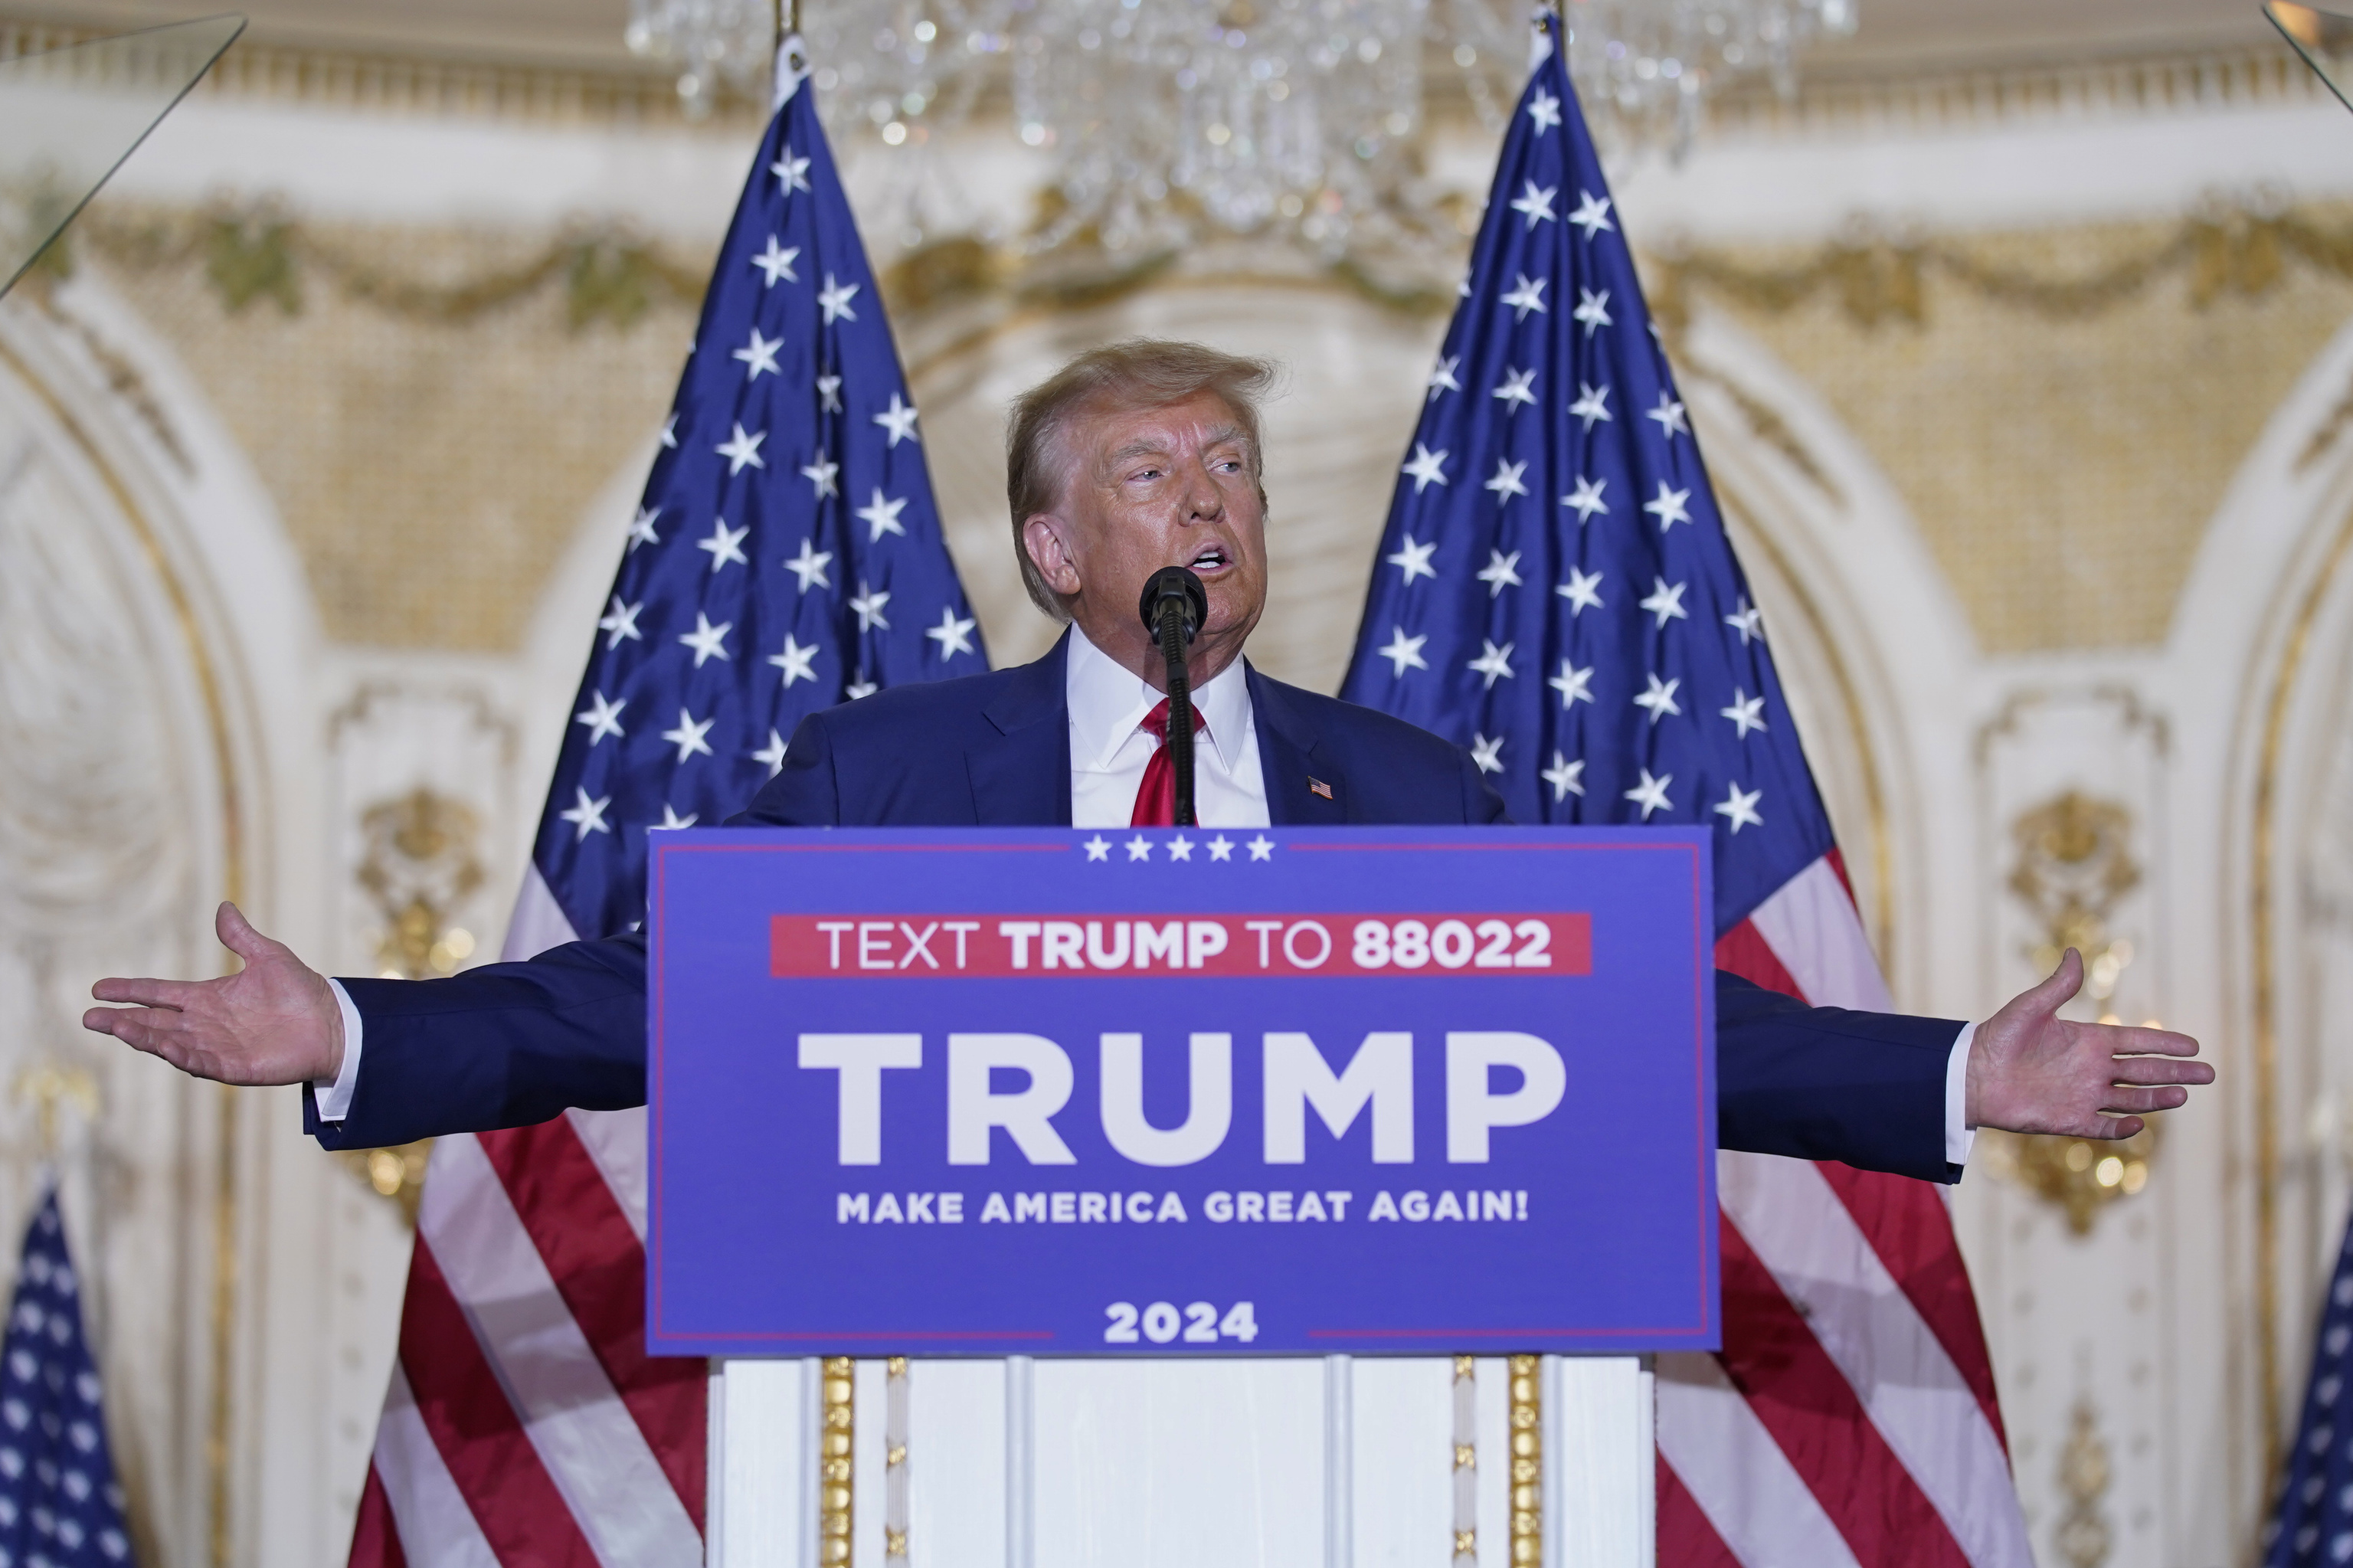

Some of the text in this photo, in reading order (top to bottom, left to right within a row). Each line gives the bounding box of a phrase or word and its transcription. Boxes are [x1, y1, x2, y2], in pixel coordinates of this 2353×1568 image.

[817, 920, 1552, 969] TEXT TRUMP TO 88022
[798, 1032, 1566, 1166] TRUMP
[837, 1190, 1528, 1223] MAKE AMERICA GREAT AGAIN!
[1105, 1301, 1258, 1343] 2024
